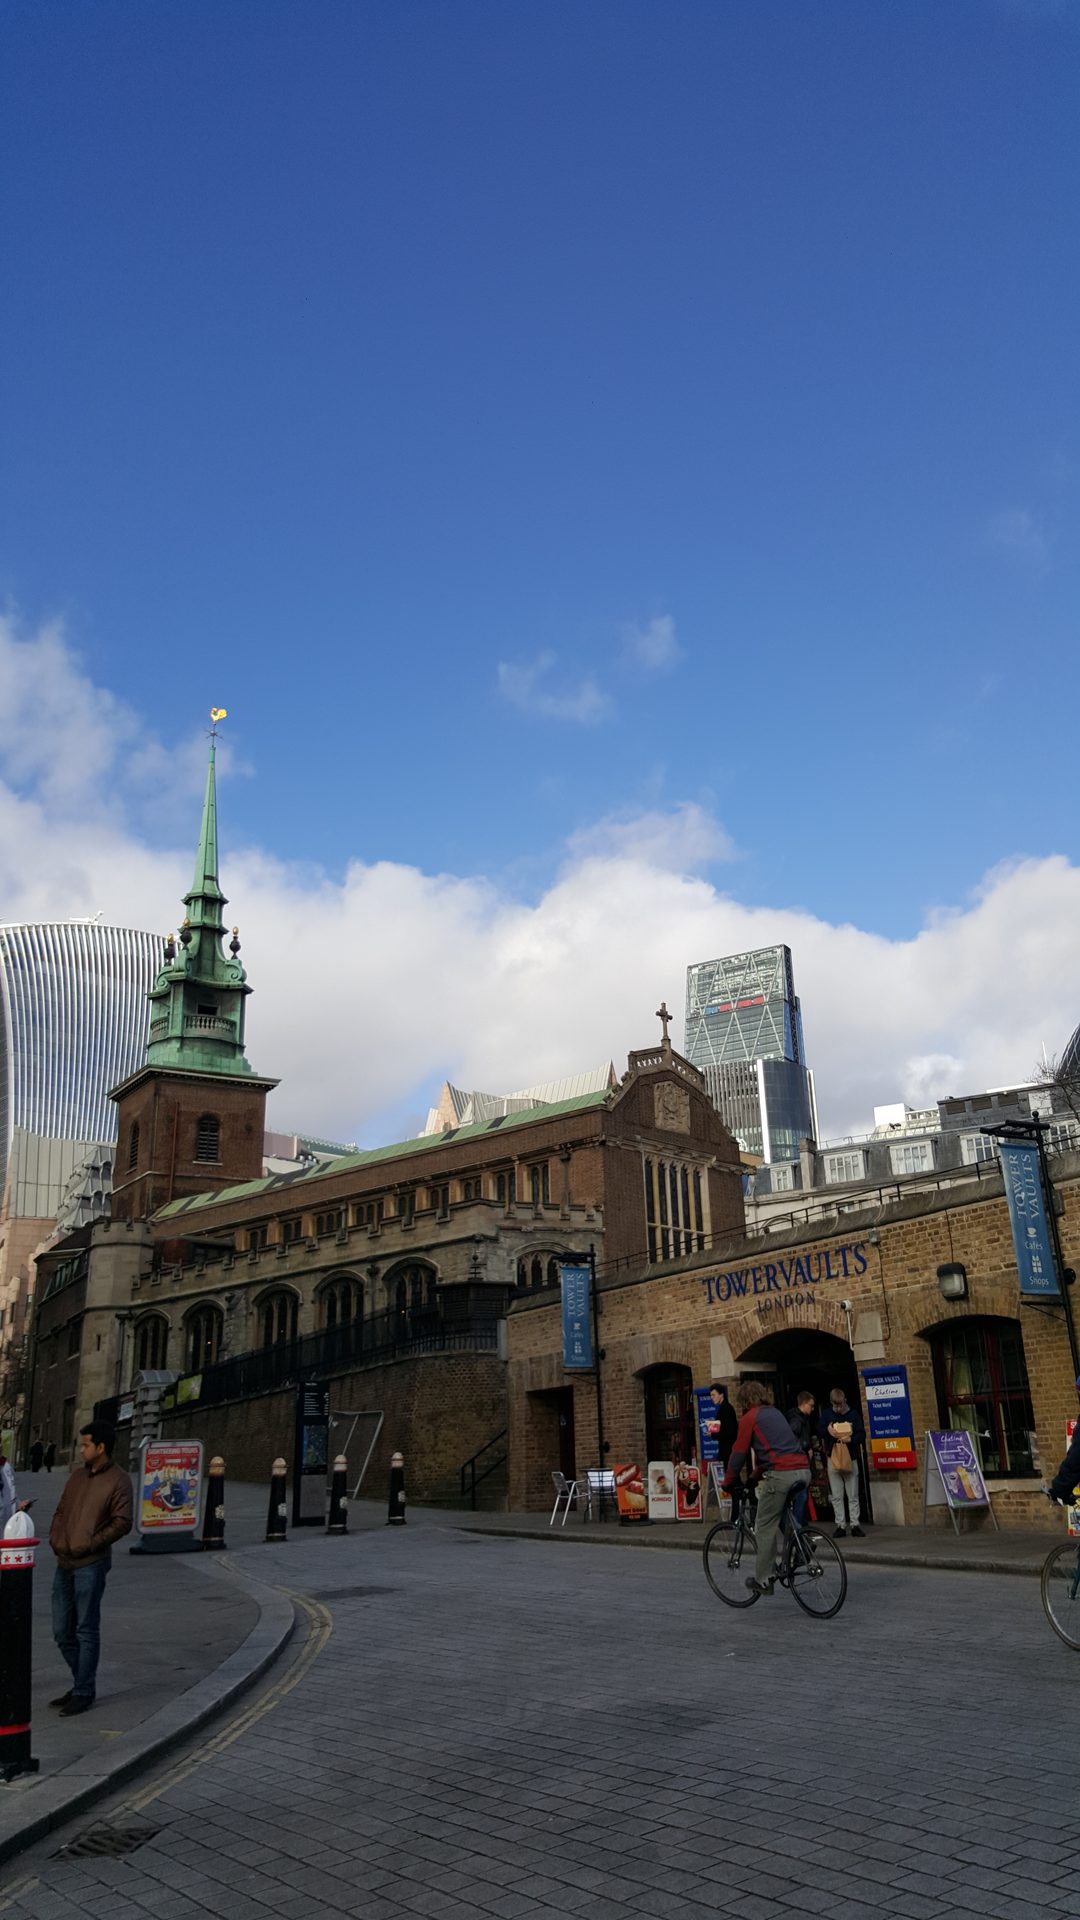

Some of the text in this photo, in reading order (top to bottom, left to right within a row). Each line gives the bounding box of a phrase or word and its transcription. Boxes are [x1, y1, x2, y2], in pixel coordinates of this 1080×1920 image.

[1008, 1154, 1027, 1219] TOWER
[1022, 1154, 1040, 1219] VAULTS
[567, 1273, 575, 1317] TOWER
[576, 1273, 584, 1317] VAULTS
[756, 1290, 816, 1313] LONDON
[1029, 1276, 1049, 1287] Shops
[868, 1377, 884, 1385] TOWER
